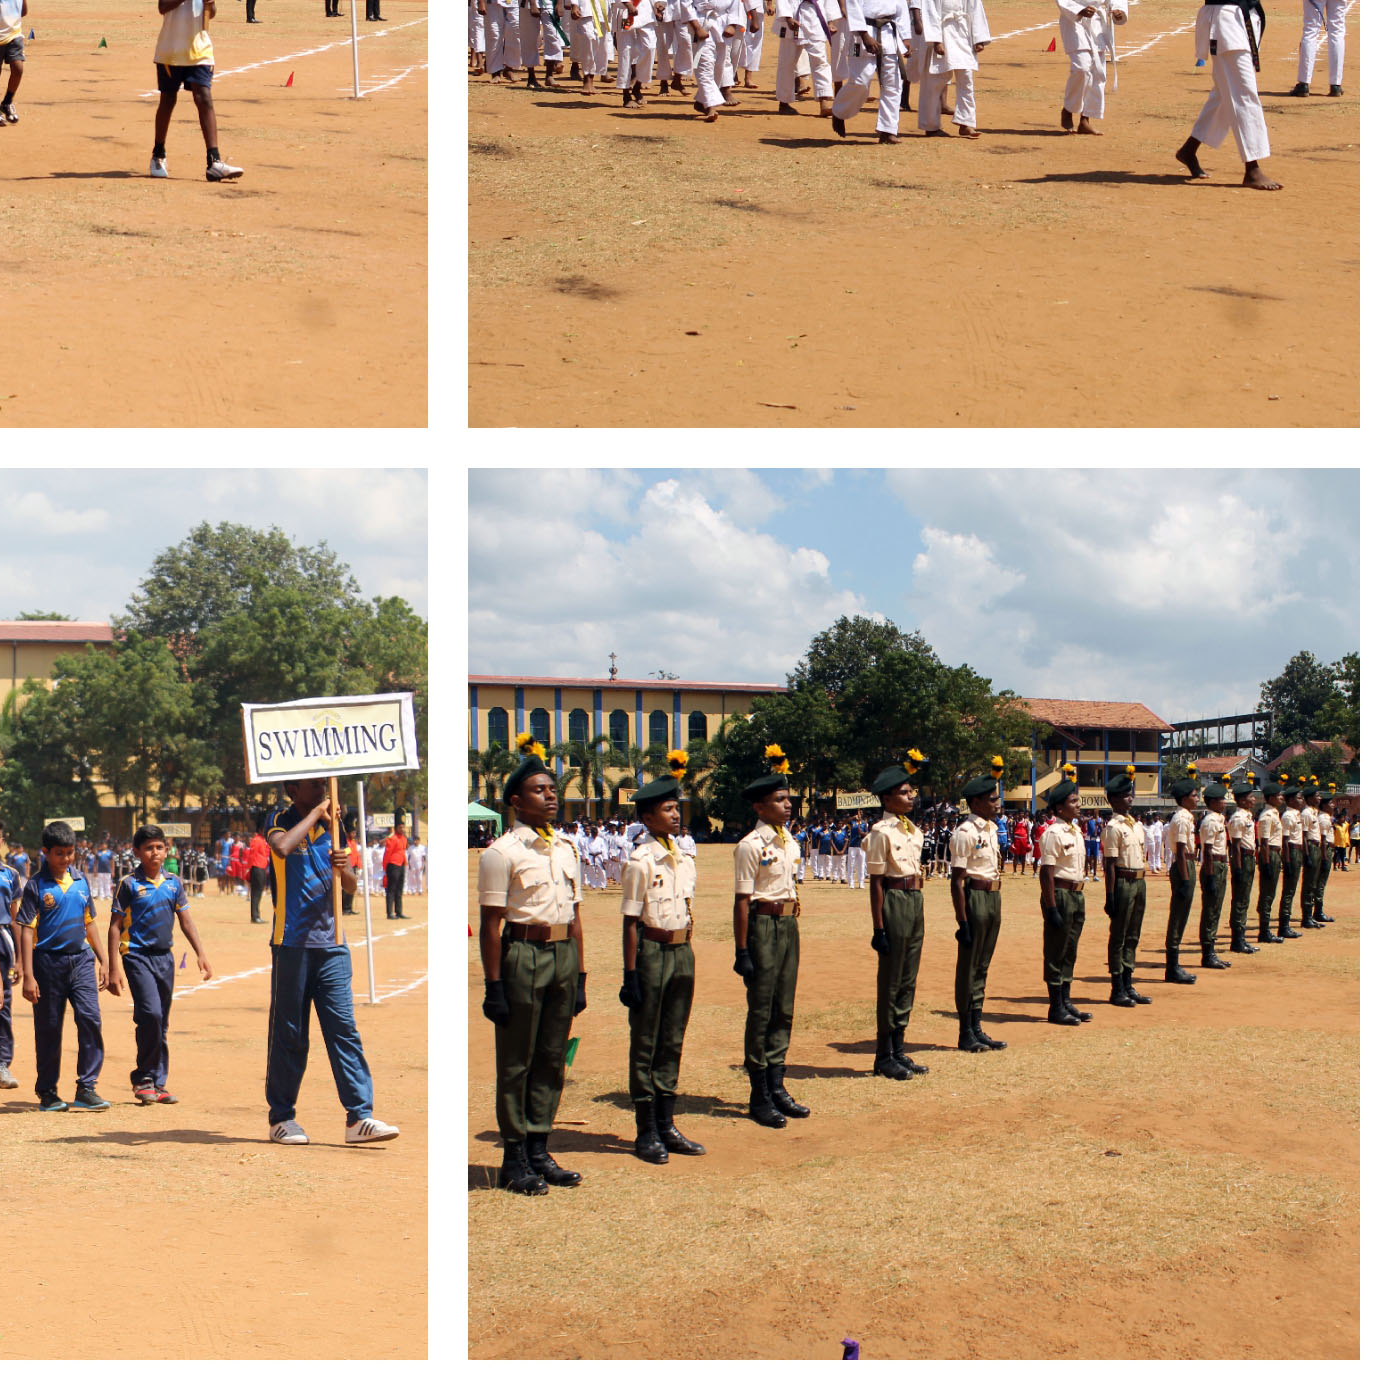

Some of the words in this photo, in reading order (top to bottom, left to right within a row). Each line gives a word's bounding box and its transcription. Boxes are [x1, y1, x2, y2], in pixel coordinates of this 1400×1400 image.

[258, 723, 397, 761] SWIMMING
[837, 794, 880, 807] BADMINTON
[1081, 796, 1111, 806] BOXIN
